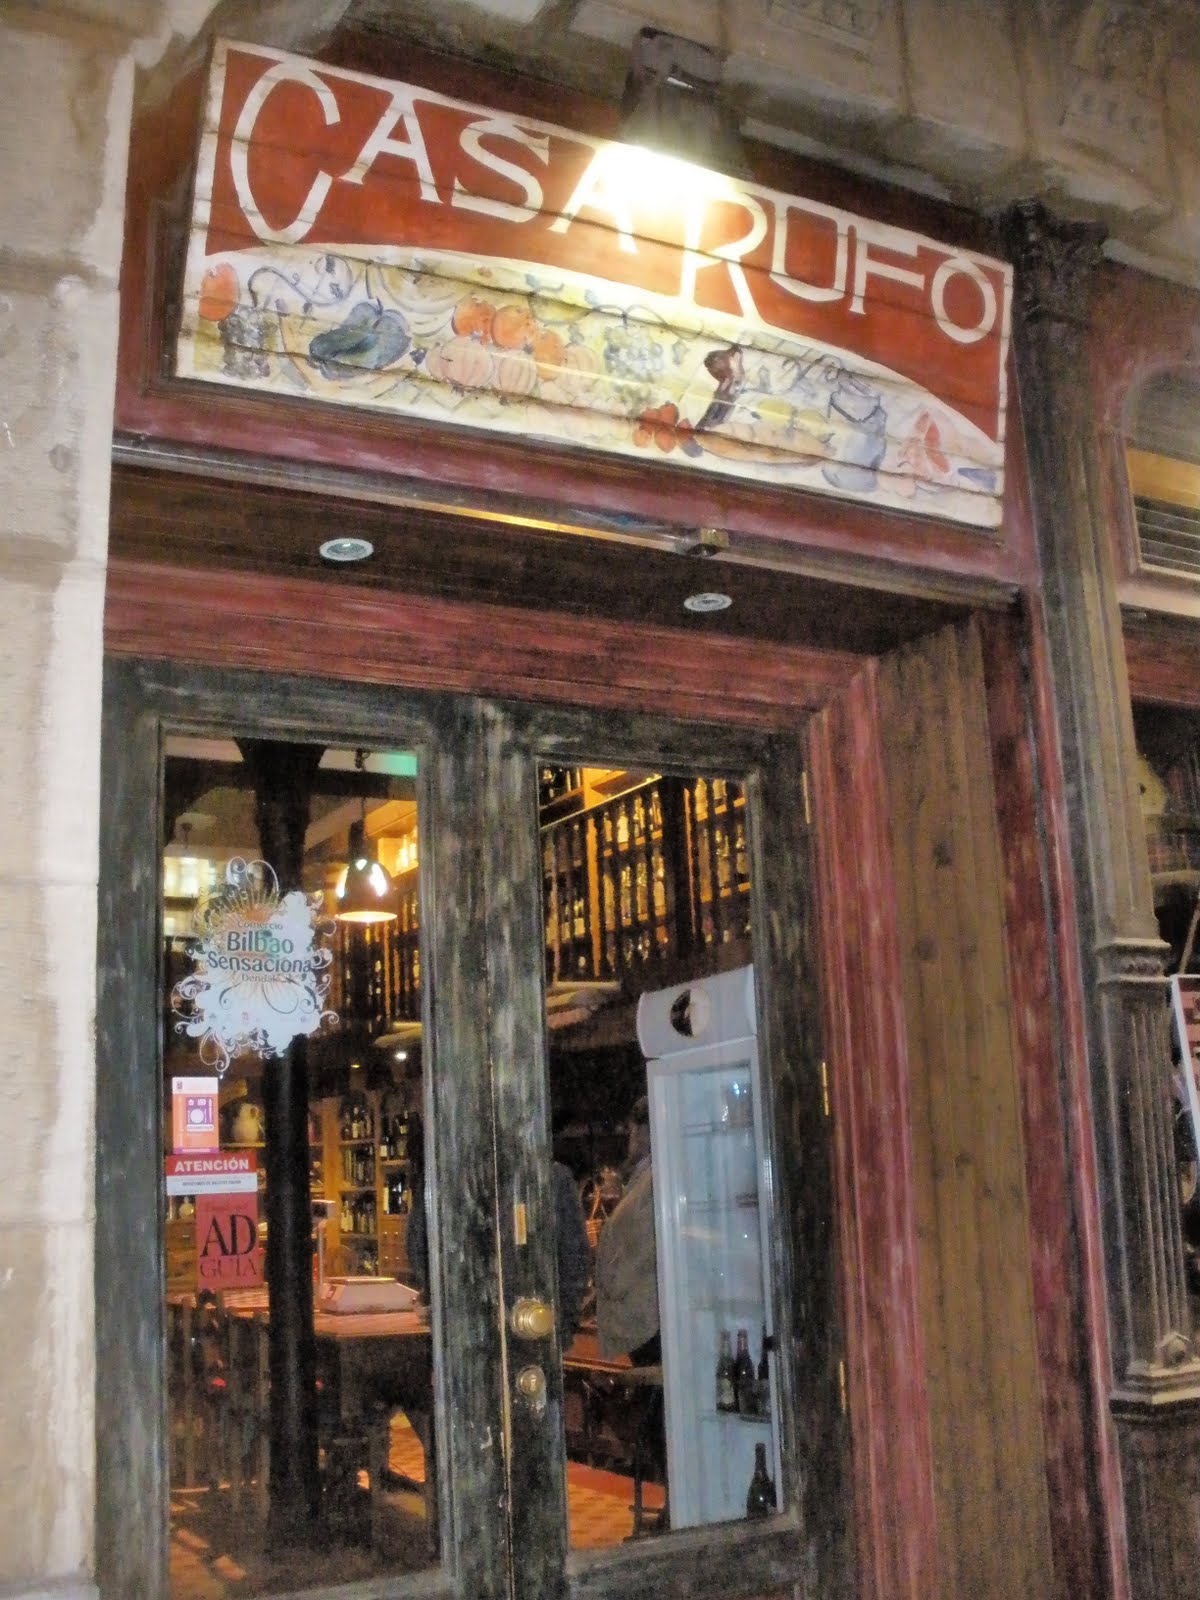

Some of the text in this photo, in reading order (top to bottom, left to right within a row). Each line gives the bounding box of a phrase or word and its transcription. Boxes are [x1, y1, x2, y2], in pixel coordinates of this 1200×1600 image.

[228, 58, 998, 345] CASA RUFO
[227, 930, 294, 954] Bilbao
[174, 1156, 249, 1173] ATENCIÓN
[199, 1214, 257, 1257] AD
